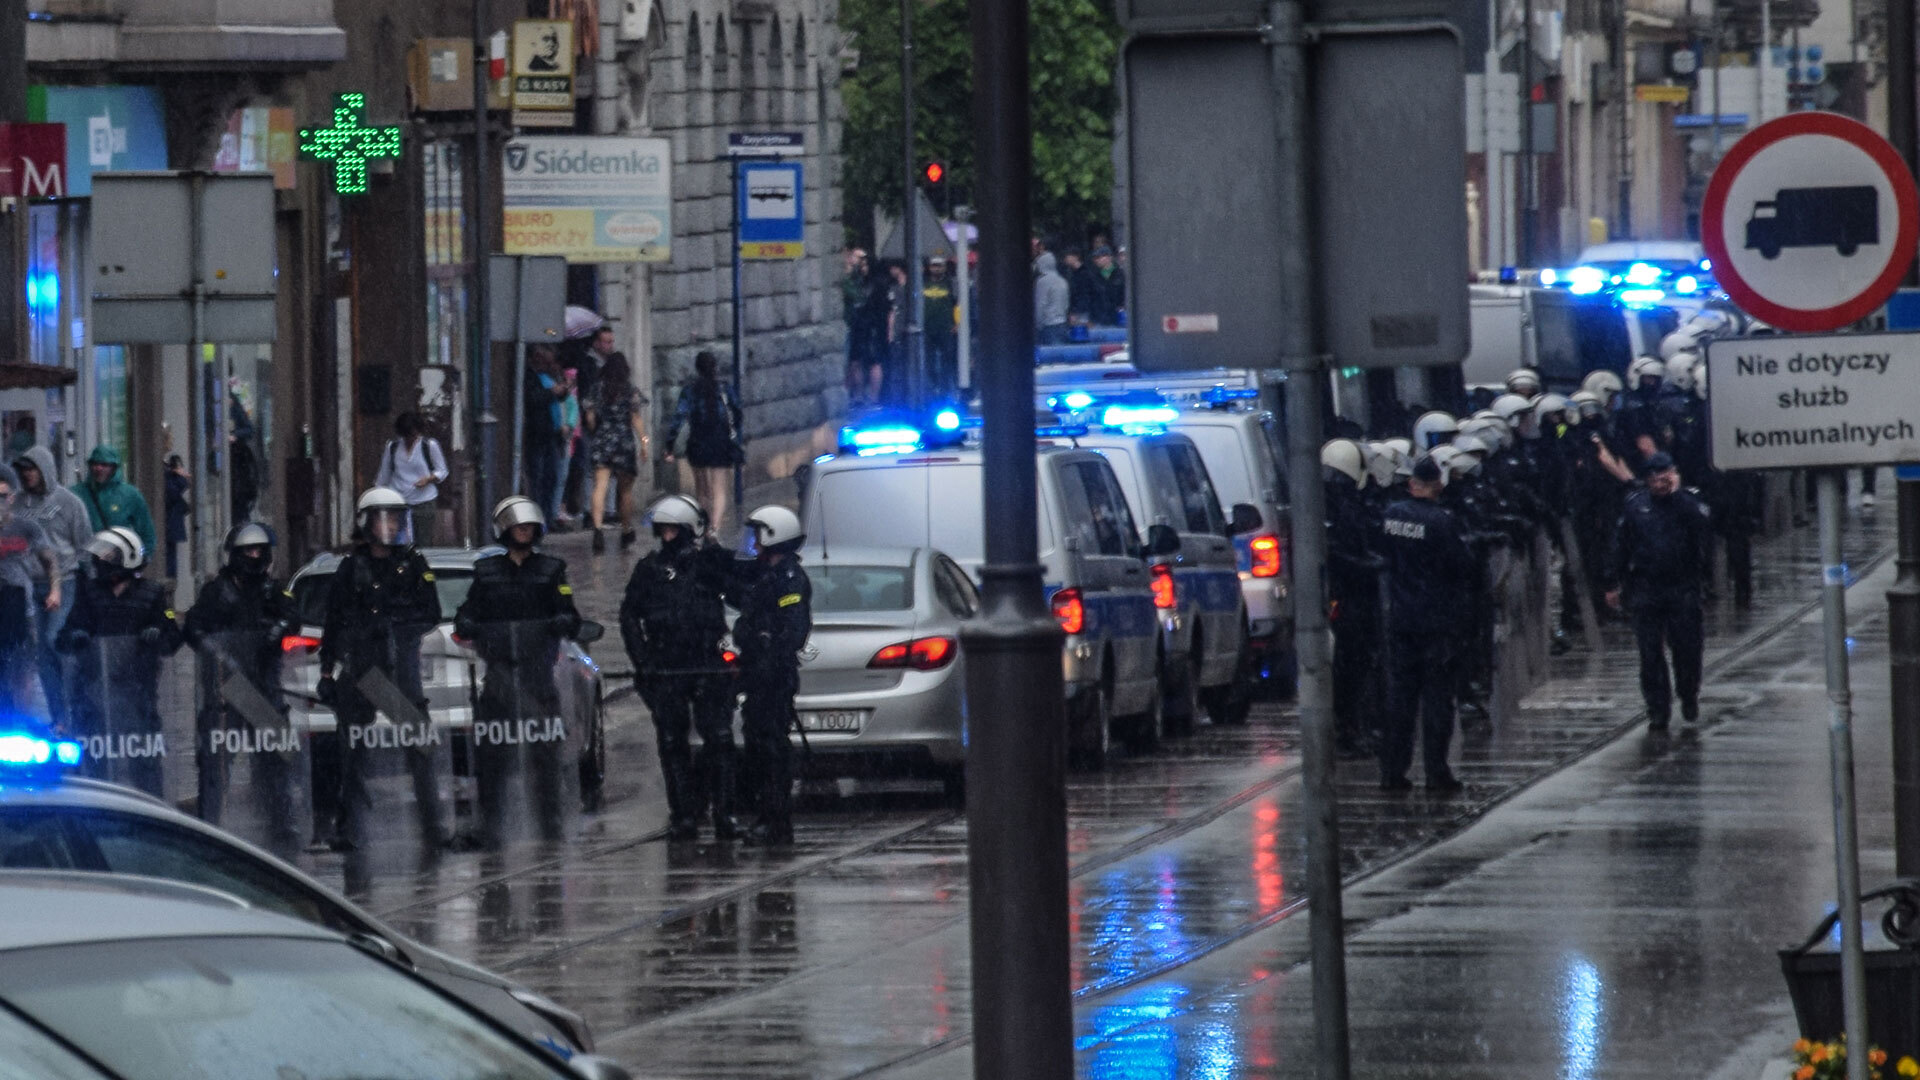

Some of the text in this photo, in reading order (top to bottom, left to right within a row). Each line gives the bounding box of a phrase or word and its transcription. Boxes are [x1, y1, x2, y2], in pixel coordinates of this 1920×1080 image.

[533, 148, 660, 174] Siódemka
[503, 212, 554, 227] BIURO
[1736, 352, 1891, 376] Nie dotyczy
[1778, 386, 1849, 409] służb
[1735, 419, 1914, 448] komunalnych
[1384, 518, 1425, 539] POLICJA
[210, 727, 300, 754] POLICJA
[349, 721, 441, 749] POLICJA
[474, 717, 566, 745] POLICJA
